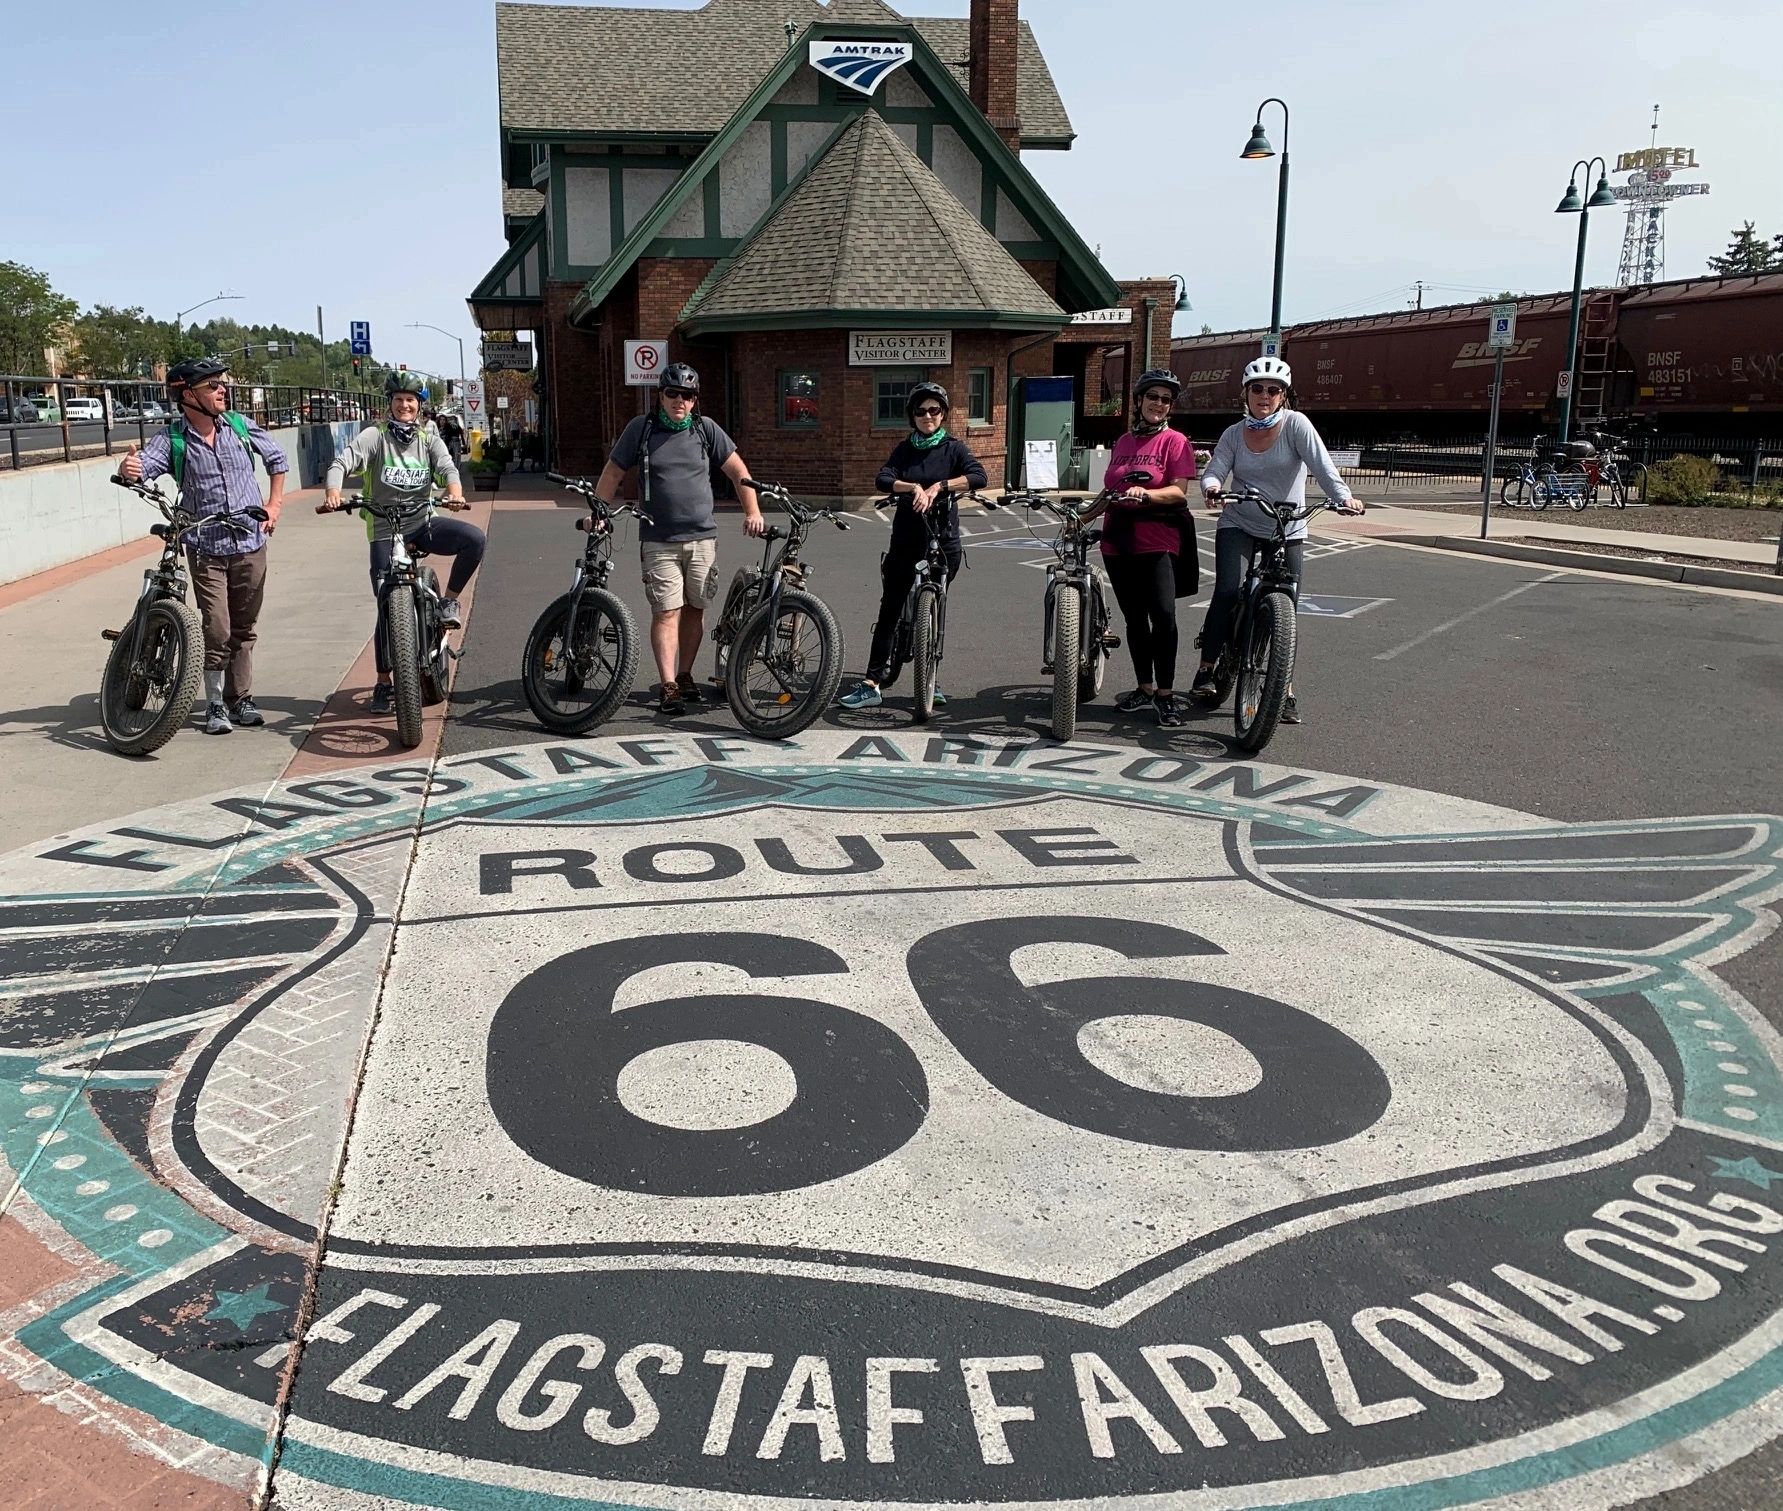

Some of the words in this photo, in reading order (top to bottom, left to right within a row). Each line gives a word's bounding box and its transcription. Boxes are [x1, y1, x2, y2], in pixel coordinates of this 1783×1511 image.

[833, 46, 905, 54] AMTRAK
[1621, 147, 1699, 171] MOTEL
[353, 322, 367, 339] H
[855, 335, 947, 348] FLAGSTAFF
[1457, 338, 1542, 358] BNSF
[855, 350, 900, 361] VISITOR
[903, 349, 947, 361] CENTER
[1648, 352, 1682, 366] BNSF
[1317, 359, 1335, 370] BNSF
[1189, 369, 1231, 381] BNSF
[1316, 374, 1343, 385] 486407
[1649, 369, 1691, 383] 483151
[384, 467, 430, 479] FLAGSTAFF
[35, 737, 749, 873] FLAGSTAFF
[836, 735, 1382, 819] ARIZONA
[479, 826, 1141, 895] ROUTE
[485, 915, 1393, 1198] 66
